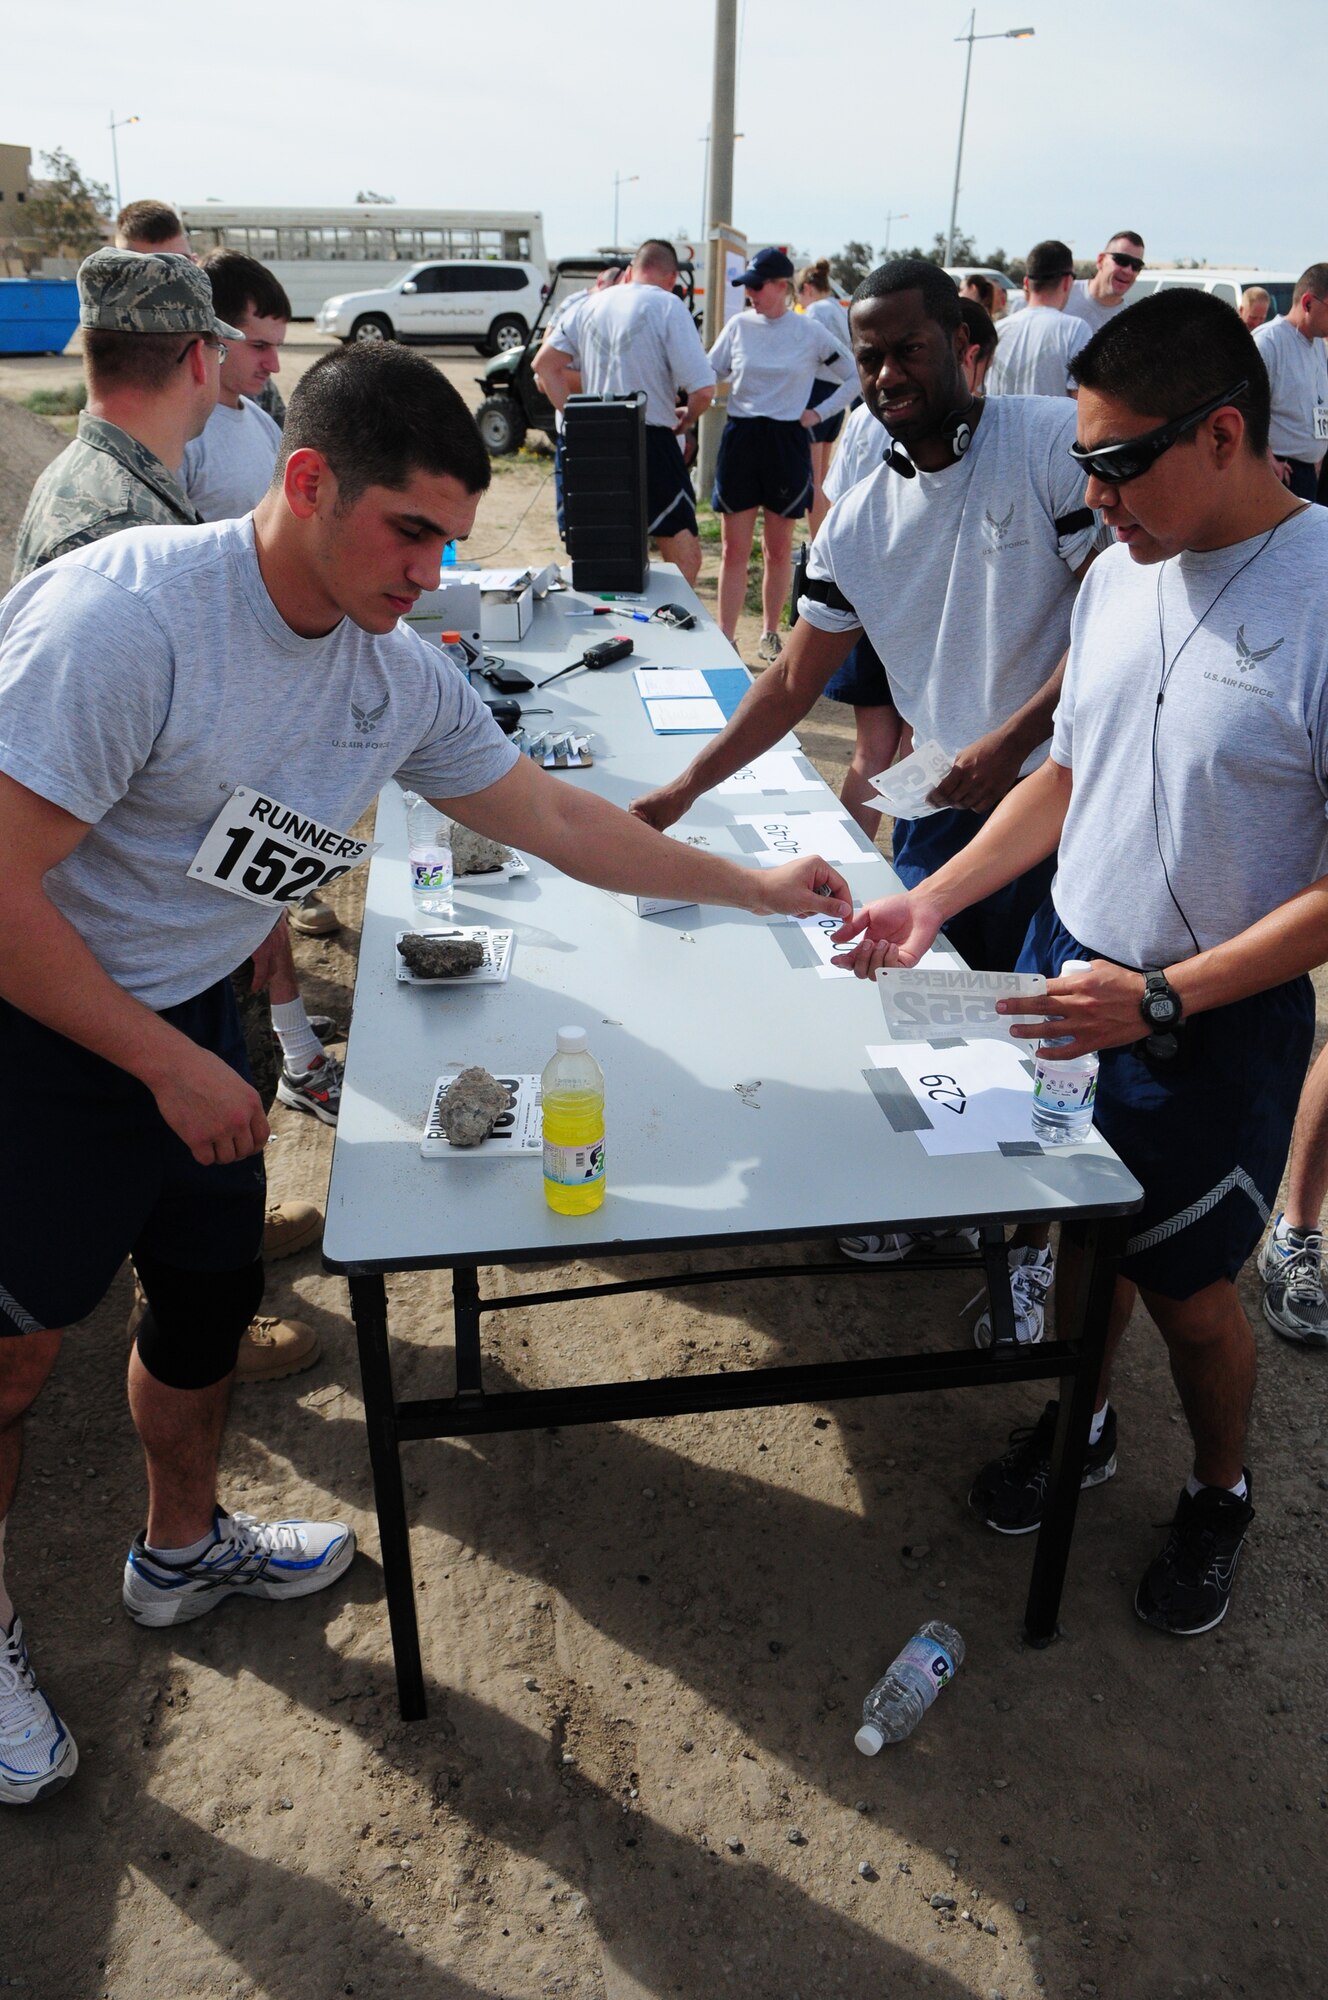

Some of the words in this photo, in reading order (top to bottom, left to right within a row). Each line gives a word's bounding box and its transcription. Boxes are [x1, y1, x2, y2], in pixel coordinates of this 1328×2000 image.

[1203, 671, 1219, 682] U.S.
[1220, 676, 1238, 687] AIR
[1238, 682, 1275, 699] FORCE
[349, 741, 364, 749] AIR
[763, 824, 802, 854] 40-49
[919, 1074, 967, 1115] <29
